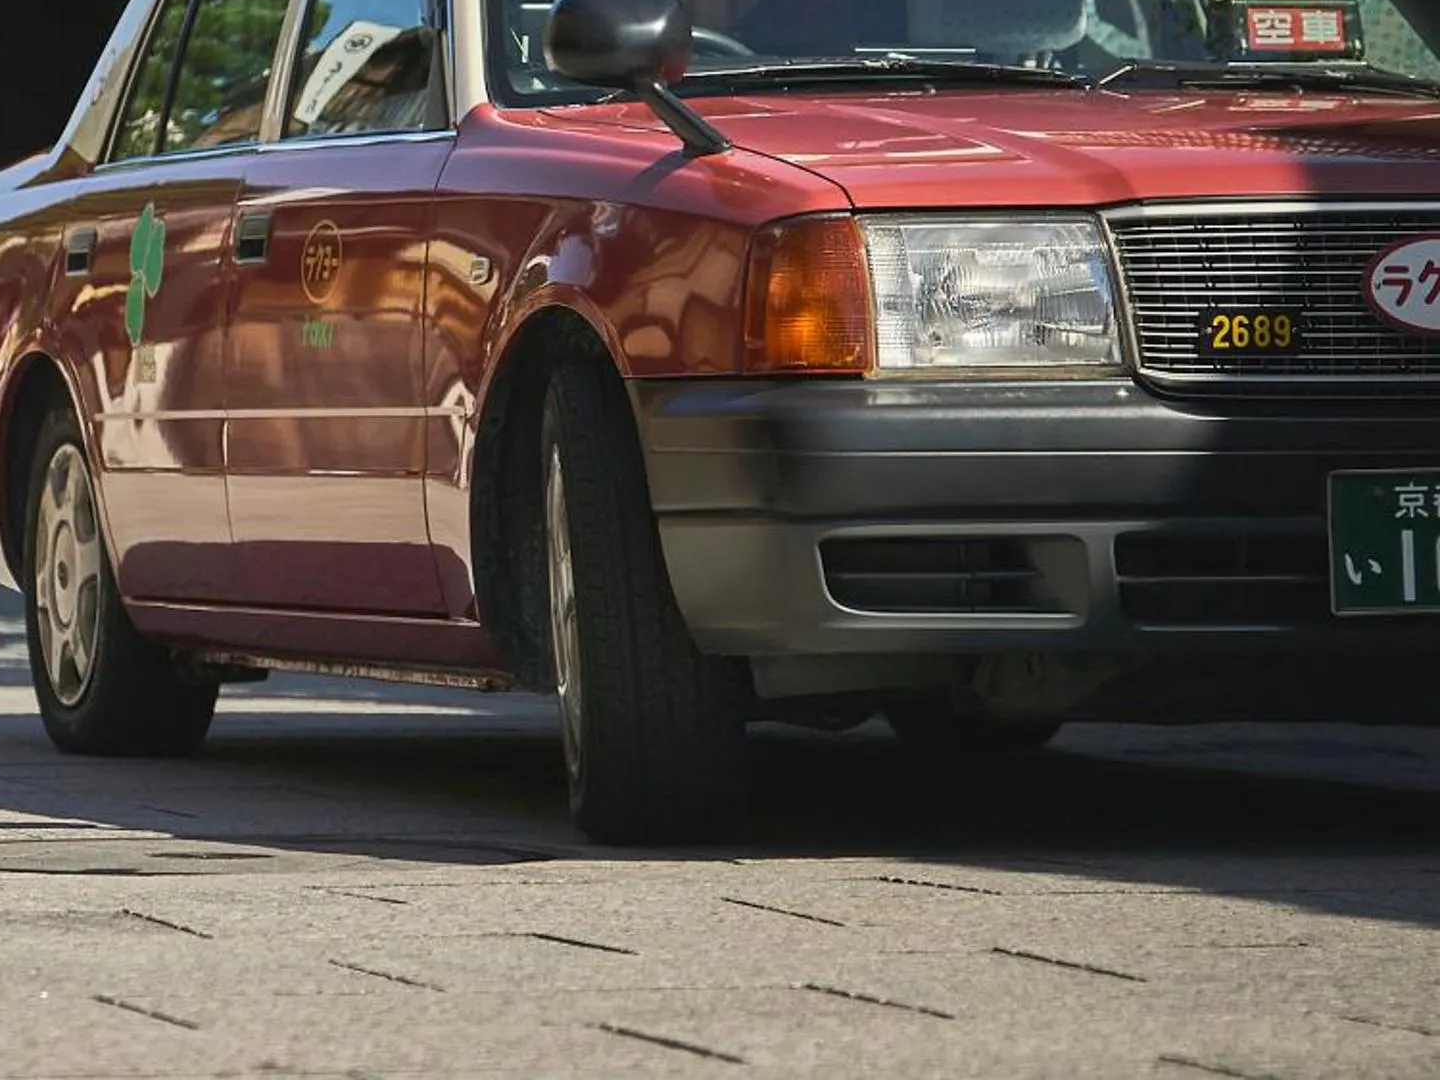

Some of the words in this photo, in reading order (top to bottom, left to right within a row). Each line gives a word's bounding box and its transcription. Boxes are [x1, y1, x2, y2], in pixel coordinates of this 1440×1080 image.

[1253, 9, 1341, 45] 空車
[1212, 314, 1292, 349] 2689
[1394, 481, 1440, 518] 京
[1344, 553, 1383, 585] い
[1401, 529, 1440, 602] 1
